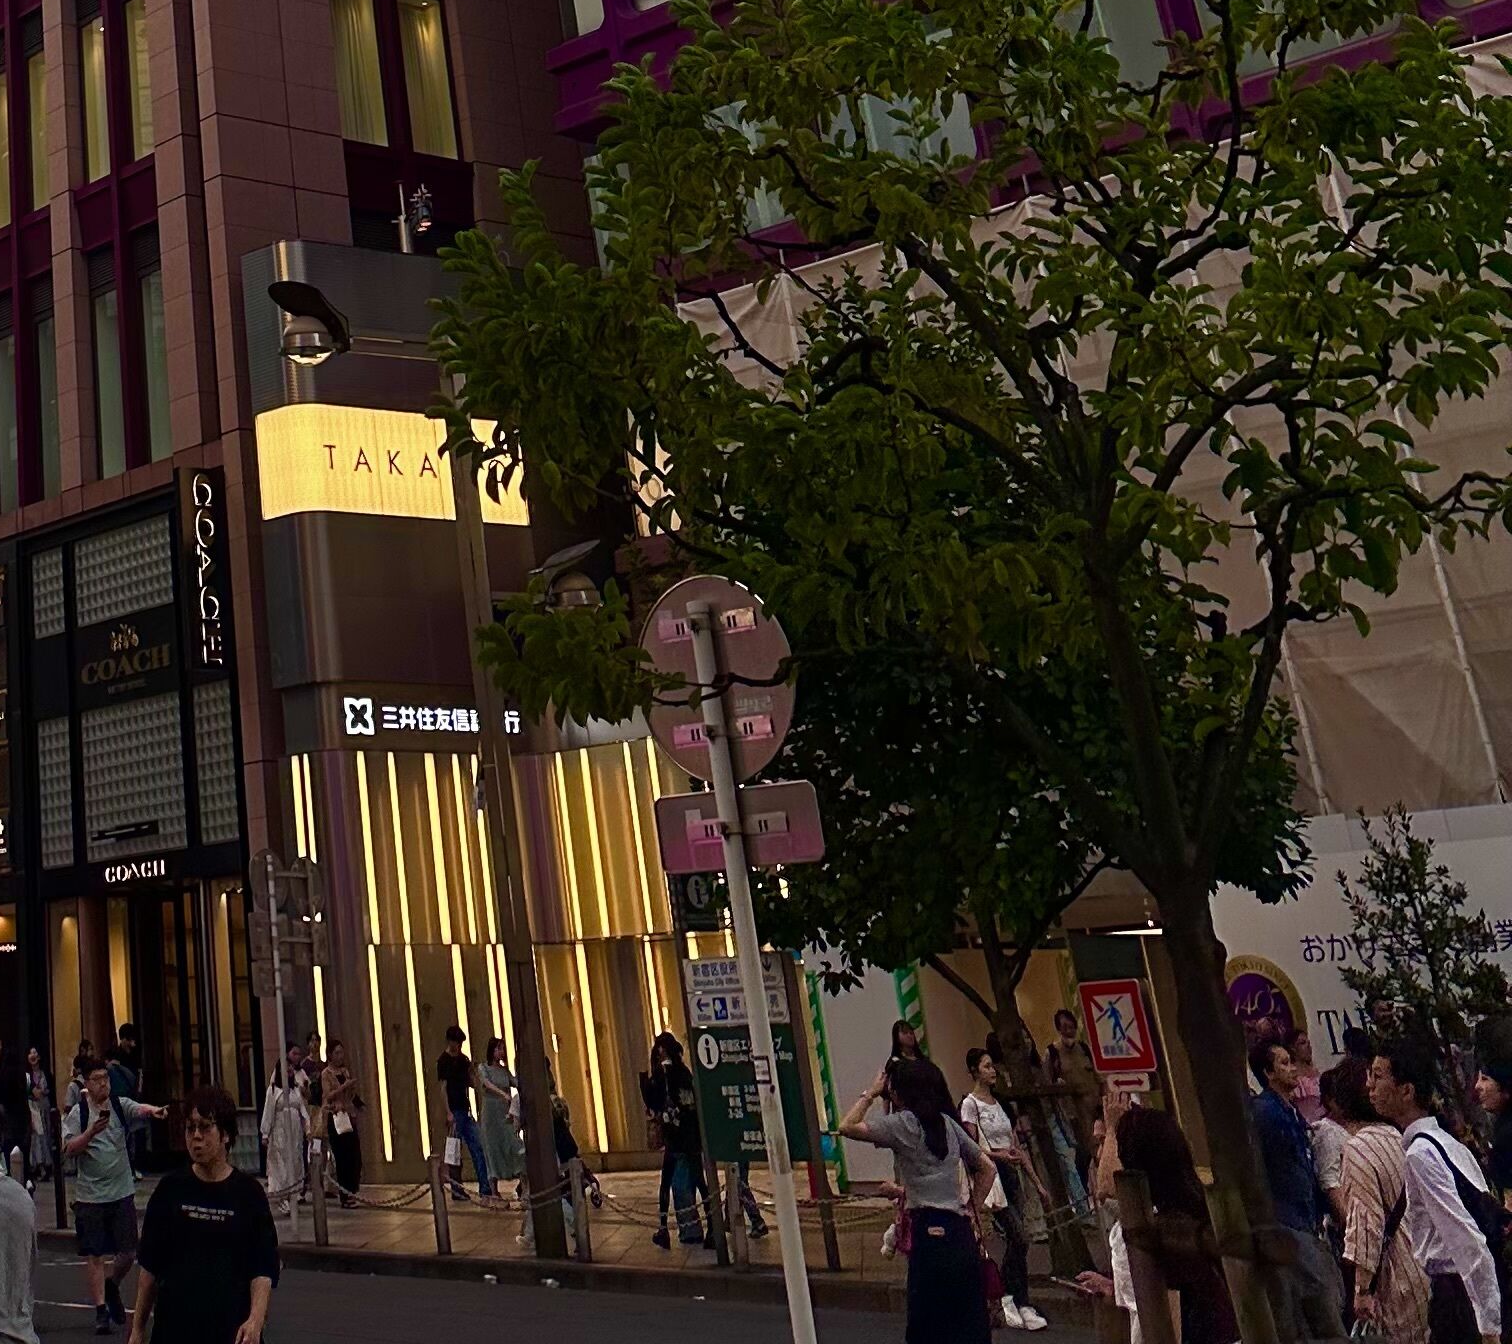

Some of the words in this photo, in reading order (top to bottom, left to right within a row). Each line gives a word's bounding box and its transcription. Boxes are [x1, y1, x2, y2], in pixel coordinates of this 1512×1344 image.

[322, 443, 439, 480] TAKA
[192, 462, 224, 665] COACH
[81, 642, 171, 686] COACH
[382, 706, 522, 734] 三井住友信行
[105, 859, 166, 884] COACH
